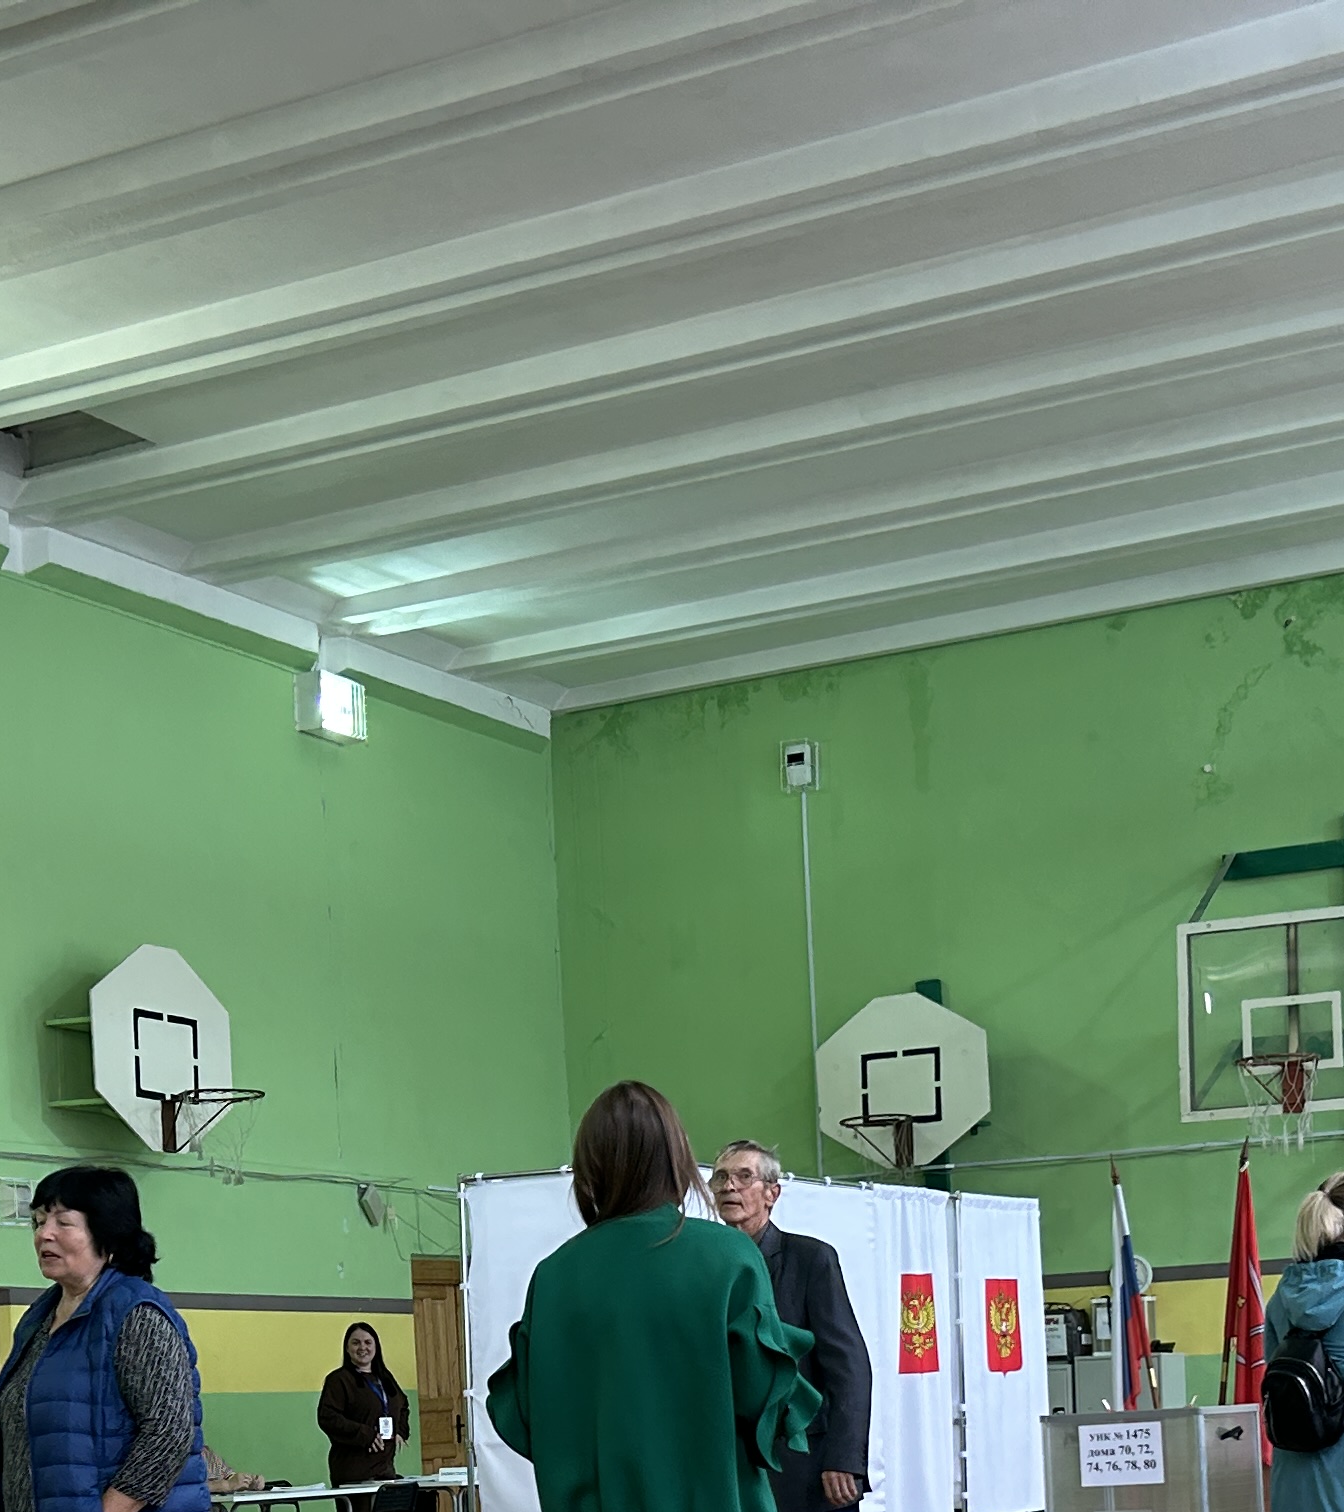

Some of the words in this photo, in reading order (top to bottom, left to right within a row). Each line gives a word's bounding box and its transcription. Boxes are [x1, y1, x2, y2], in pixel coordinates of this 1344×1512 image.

[1125, 1428, 1151, 1440] 1475
[1087, 1448, 1116, 1458] дома
[1118, 1444, 1135, 1456] 70,
[1137, 1443, 1154, 1455] 72,
[1086, 1462, 1103, 1473] 74,
[1105, 1461, 1122, 1472] 76,
[1124, 1459, 1141, 1471] 78,
[1143, 1459, 1157, 1470] 80
